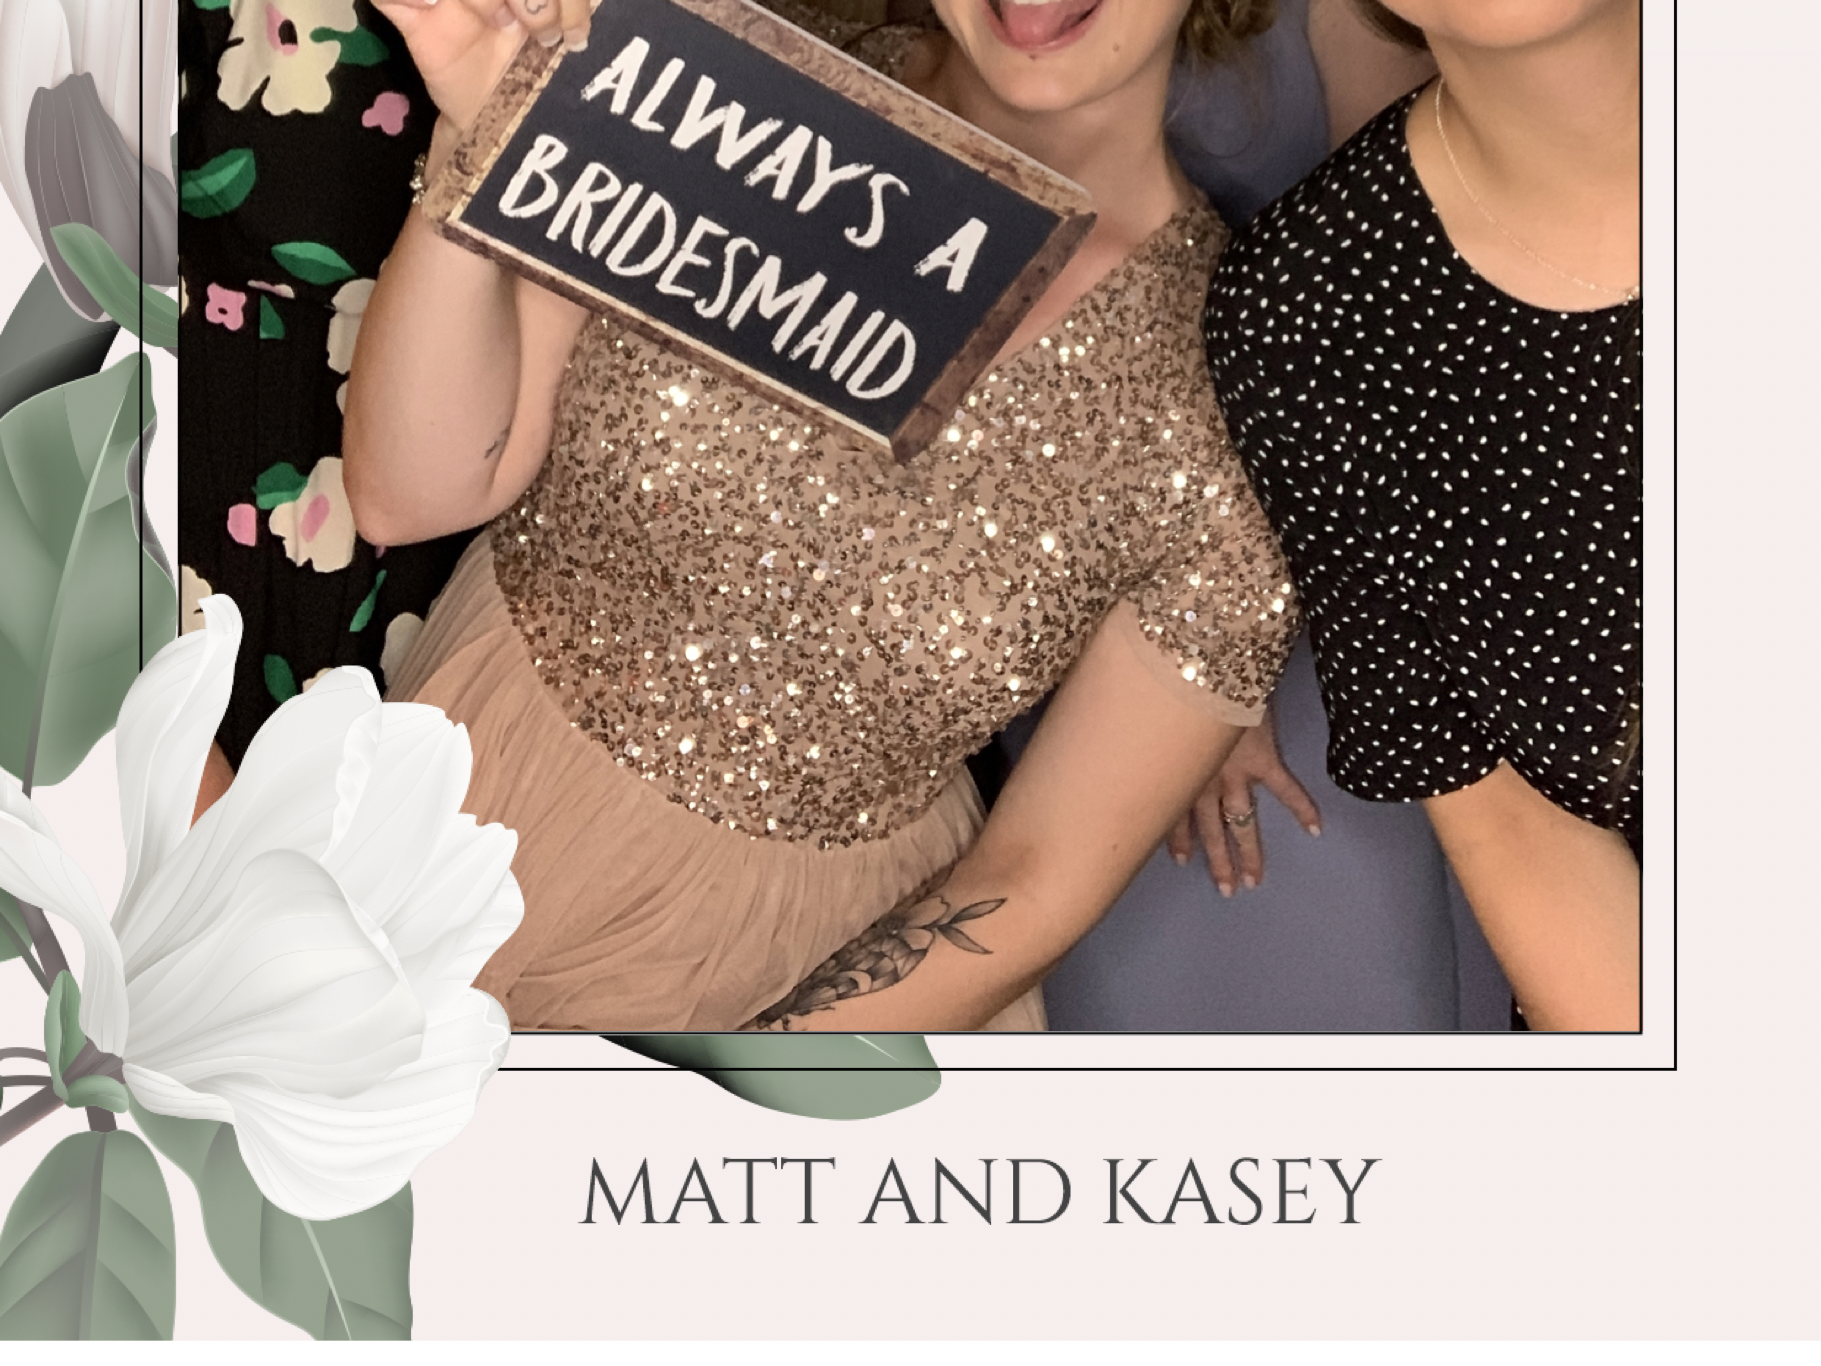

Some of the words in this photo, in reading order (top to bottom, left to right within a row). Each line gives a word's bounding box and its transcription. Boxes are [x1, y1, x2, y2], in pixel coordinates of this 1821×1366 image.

[498, 133, 917, 400] BRIDESMAID
[580, 35, 911, 249] ALWAYS
[914, 217, 988, 293] A
